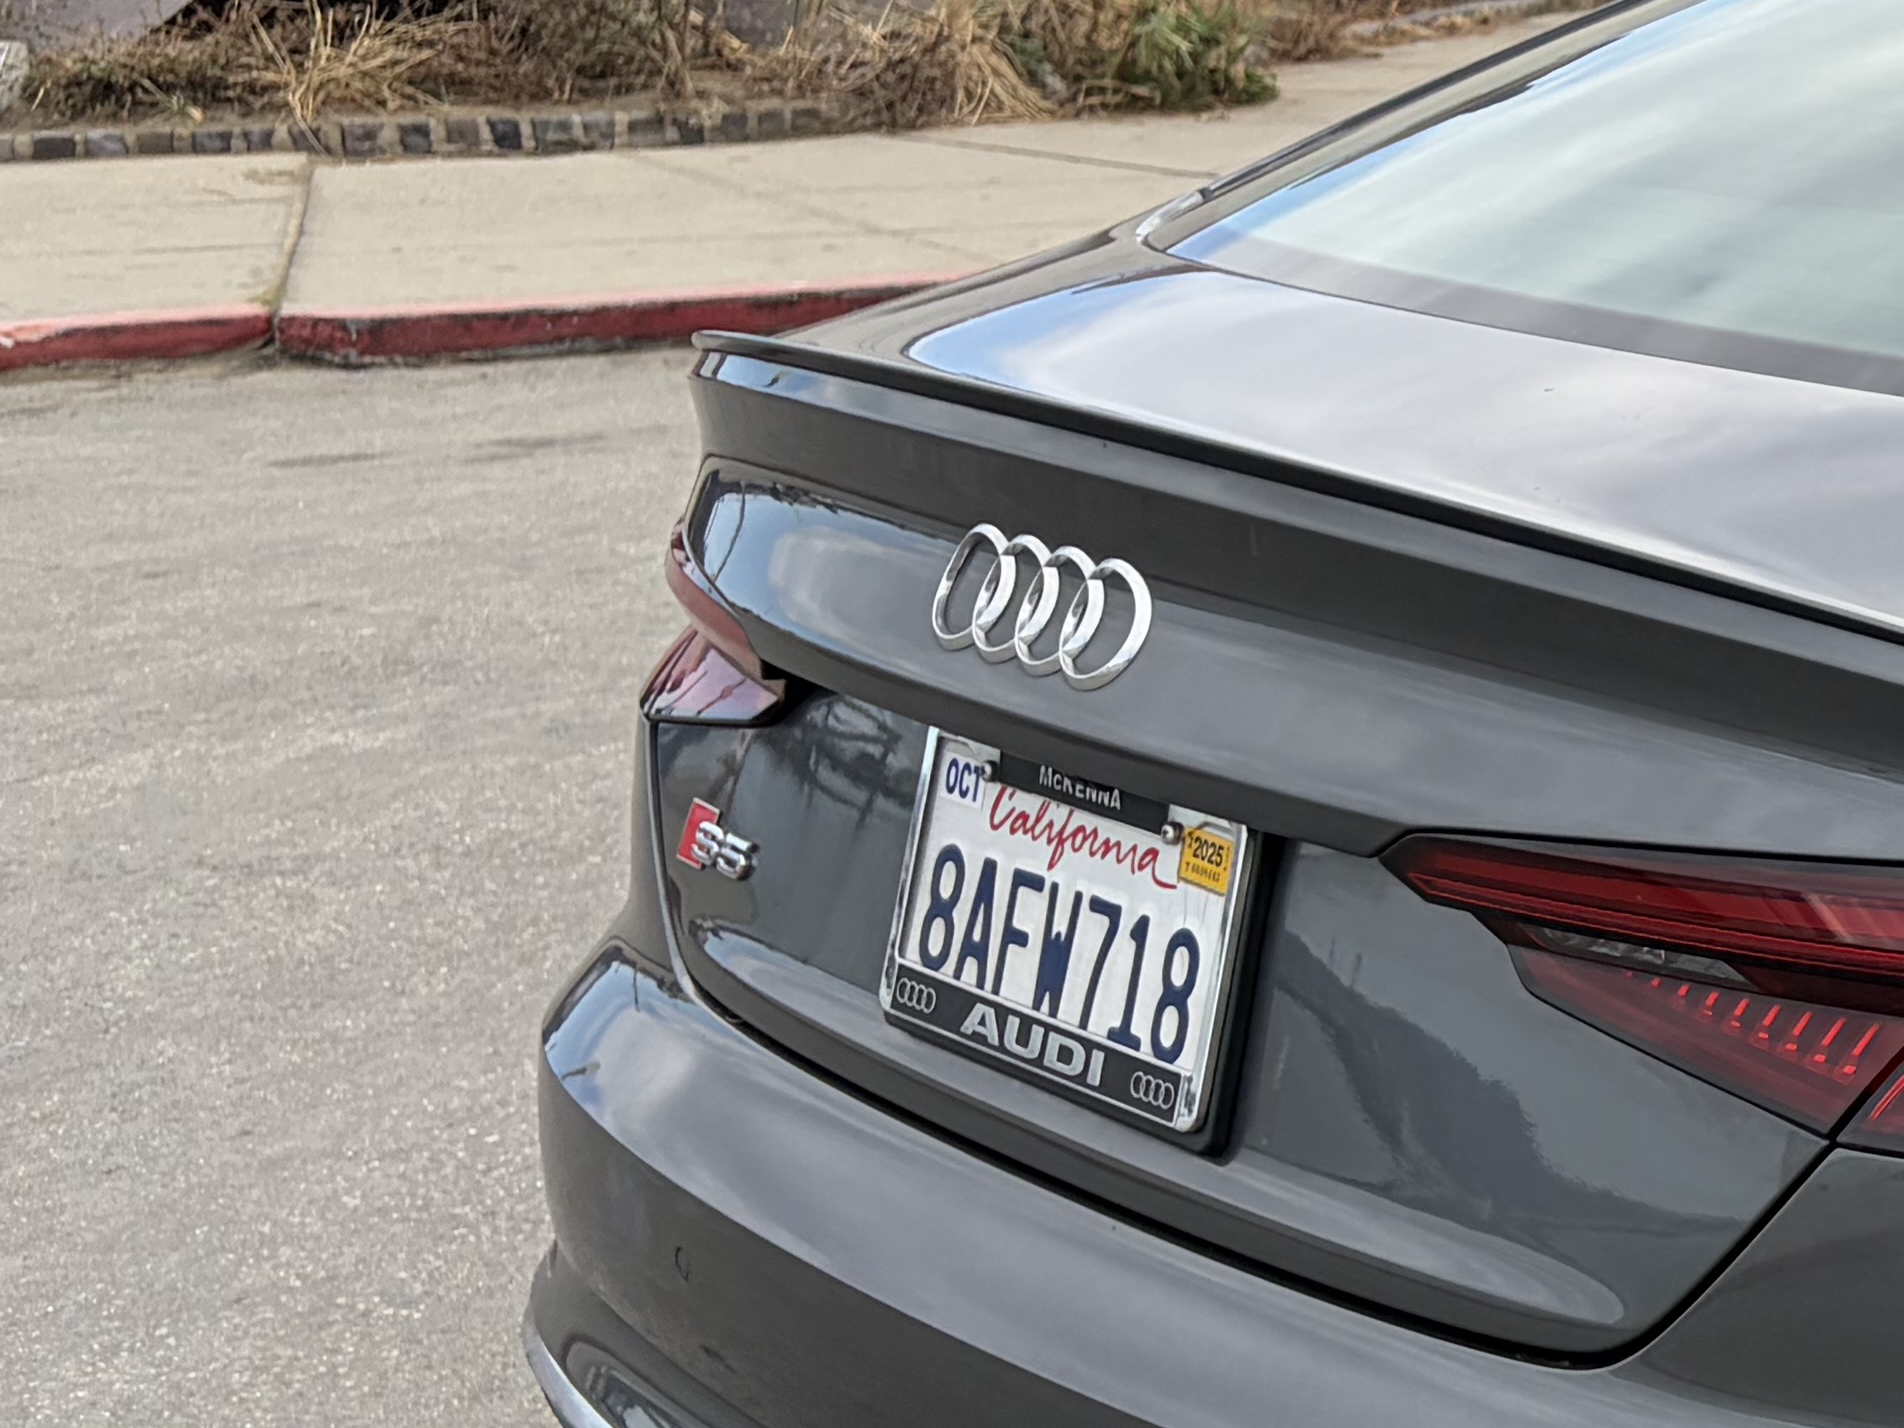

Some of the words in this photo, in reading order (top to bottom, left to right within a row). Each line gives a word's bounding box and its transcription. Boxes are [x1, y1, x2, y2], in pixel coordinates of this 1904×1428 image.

[945, 757, 984, 803] OCT
[690, 821, 752, 880] S5
[989, 785, 1178, 889] California
[1193, 836, 1224, 867] 2025
[919, 844, 1201, 1064] 8AFW718
[960, 1002, 1106, 1086] AUDI
